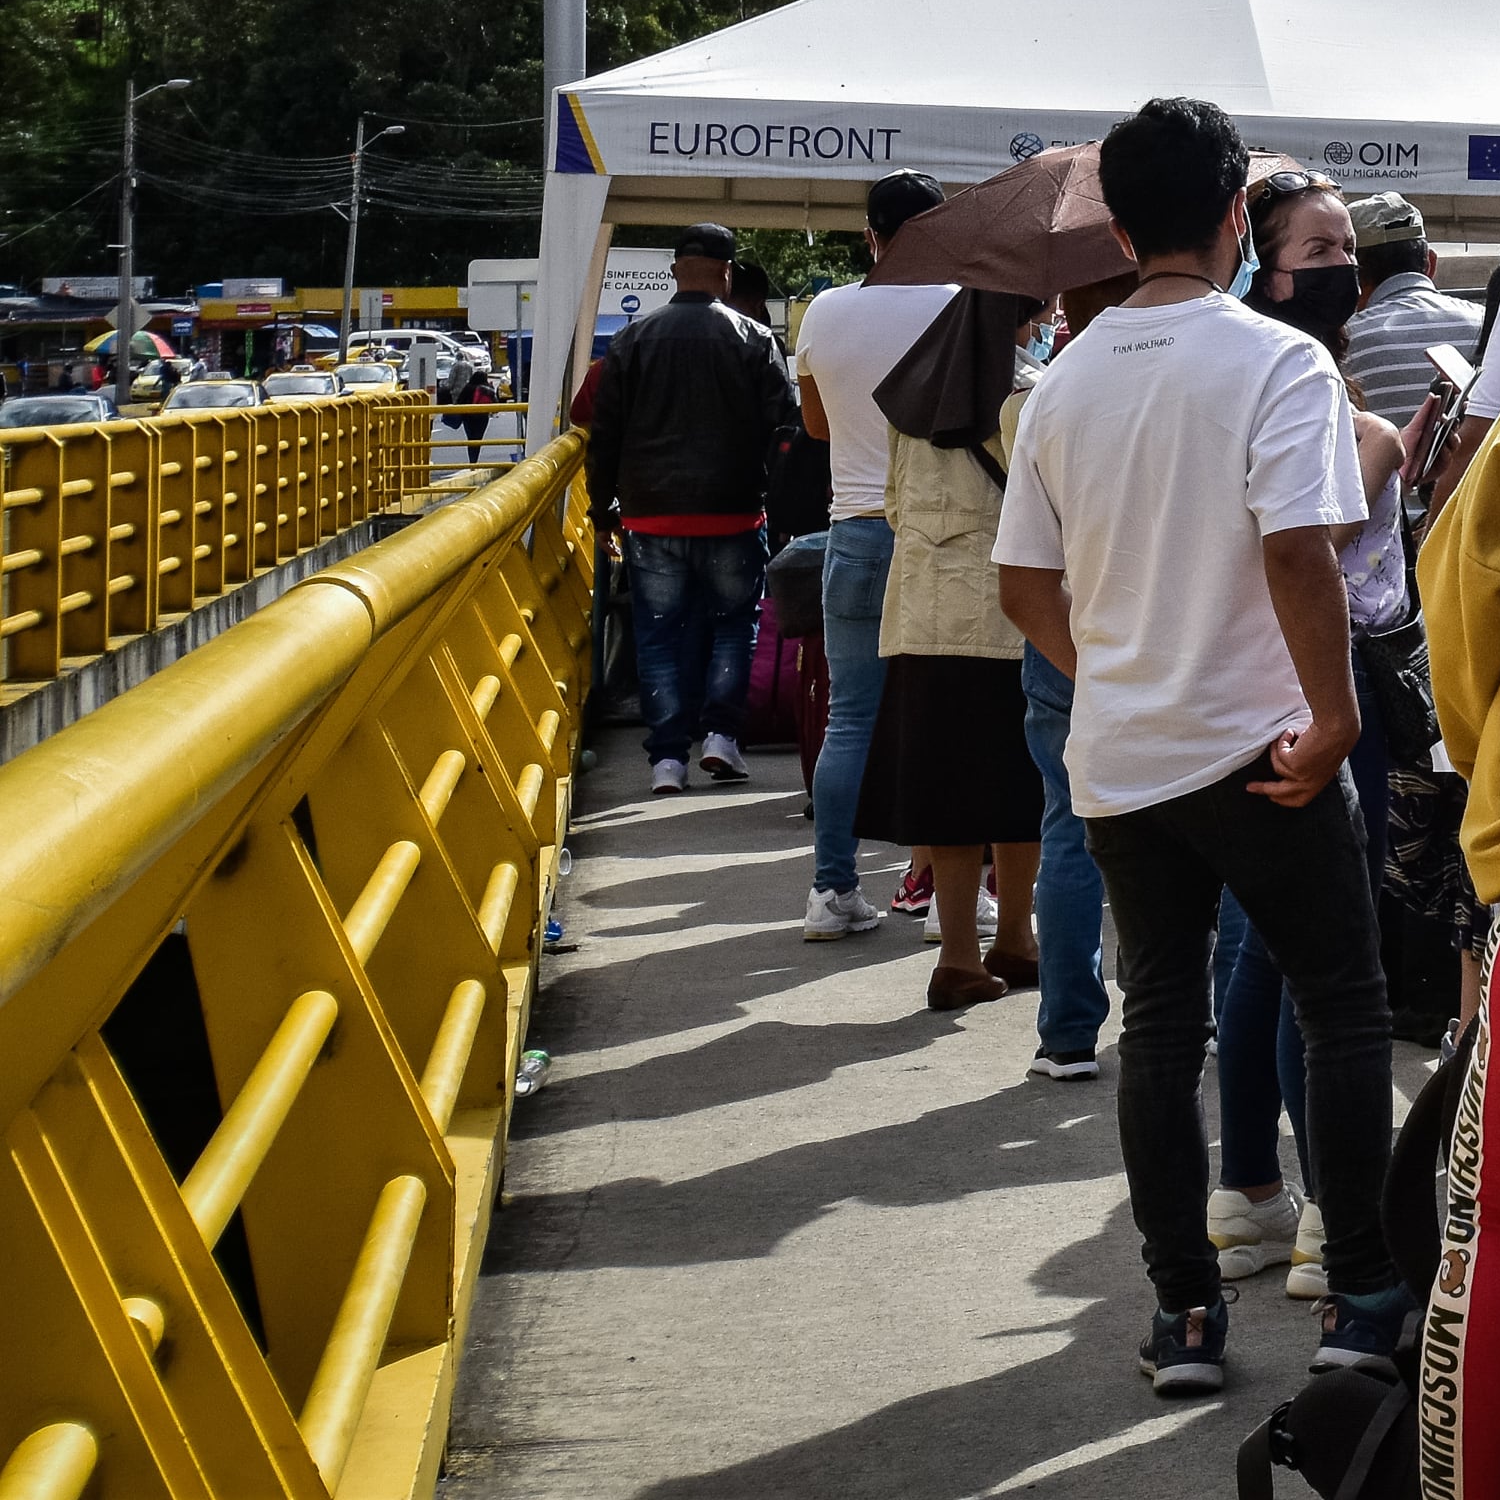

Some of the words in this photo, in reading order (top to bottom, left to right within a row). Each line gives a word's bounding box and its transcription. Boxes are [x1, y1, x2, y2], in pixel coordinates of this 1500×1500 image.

[649, 122, 901, 160] EUROFRONT
[1359, 142, 1419, 167] OIM
[1353, 167, 1418, 179] MIGRACIÓN
[614, 281, 669, 291] CALZADO
[1112, 343, 1133, 355] FINN
[1134, 336, 1175, 352] WOLFHARD
[1420, 1303, 1465, 1500] MOSCHINO
